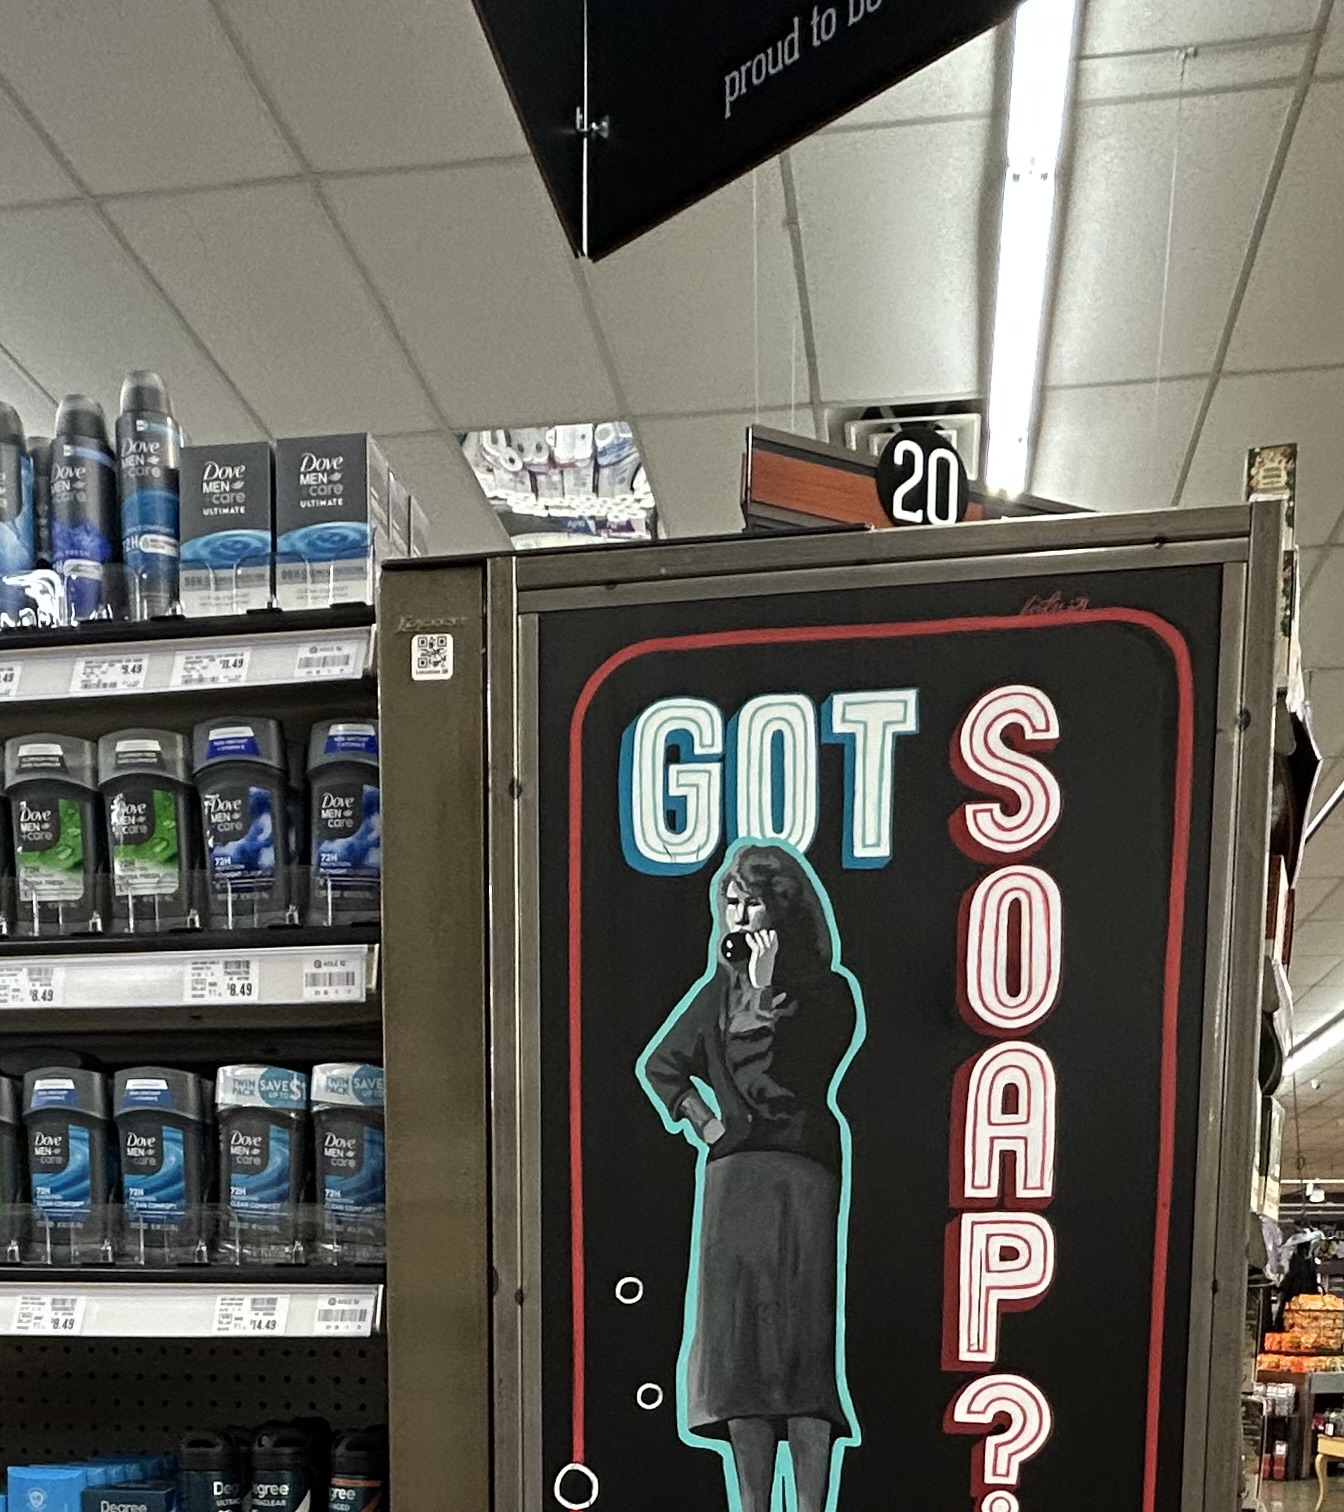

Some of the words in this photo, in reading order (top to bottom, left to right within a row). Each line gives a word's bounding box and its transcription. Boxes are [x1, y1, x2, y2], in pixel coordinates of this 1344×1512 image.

[724, 16, 800, 119] proud
[810, 5, 837, 47] to
[300, 453, 343, 473] Dove
[202, 462, 246, 482] Dove
[300, 472, 327, 486] MEN
[202, 481, 230, 494] MEN
[893, 440, 957, 525] 20
[202, 506, 246, 515] ULTIMATE
[300, 498, 344, 508] ULTIMATE
[624, 689, 919, 872] GOT
[322, 793, 355, 811] Dove
[20, 806, 52, 822] Dove
[35, 1132, 62, 1148] Dove
[127, 1132, 156, 1148] Dove
[230, 1130, 262, 1147] Dove
[324, 1132, 356, 1148] Dove
